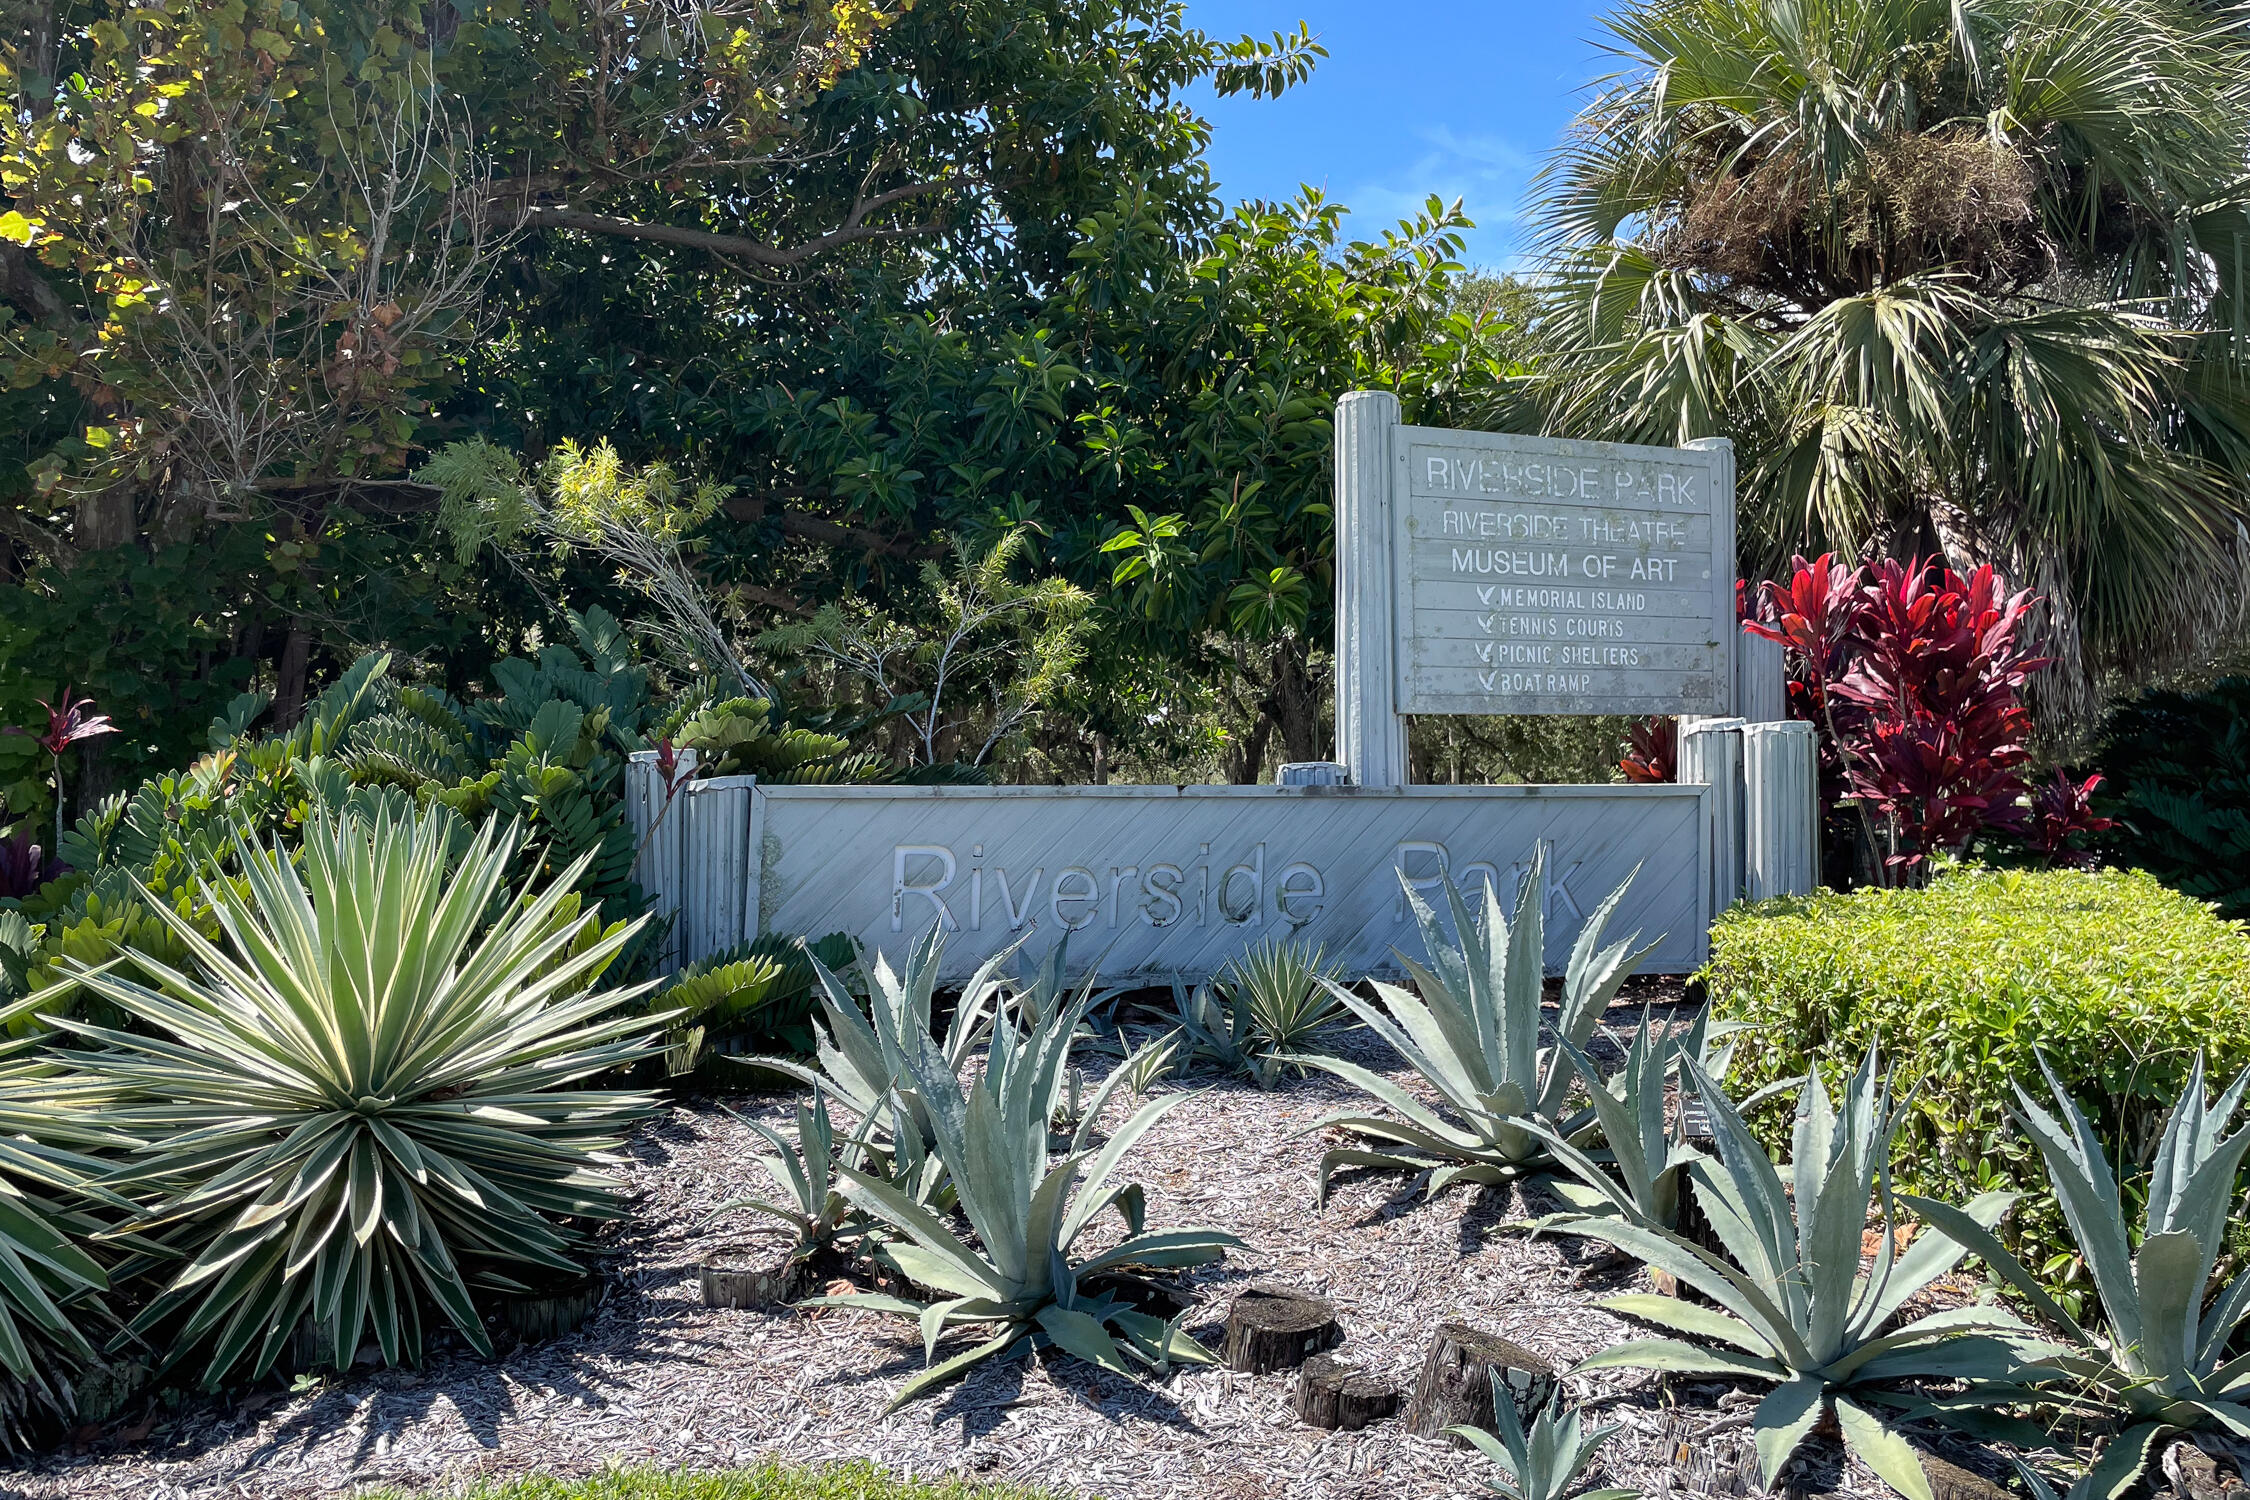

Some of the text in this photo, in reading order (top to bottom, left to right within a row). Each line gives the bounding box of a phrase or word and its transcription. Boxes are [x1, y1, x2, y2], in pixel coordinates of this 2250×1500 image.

[1426, 456, 1697, 506] RIVERSIDE PARK
[1443, 510, 1686, 546] RIVERSIDE THEATRE
[1451, 548, 1678, 582] MUSEUM OF ART
[1500, 587, 1646, 611] MEMORIAL ISLAND
[1499, 616, 1624, 638] TENNIS COURTS
[1499, 644, 1639, 666] PICNIC SHELTERS
[1501, 673, 1590, 693] BOAT RAMP
[891, 839, 1585, 932] Riverside Park
